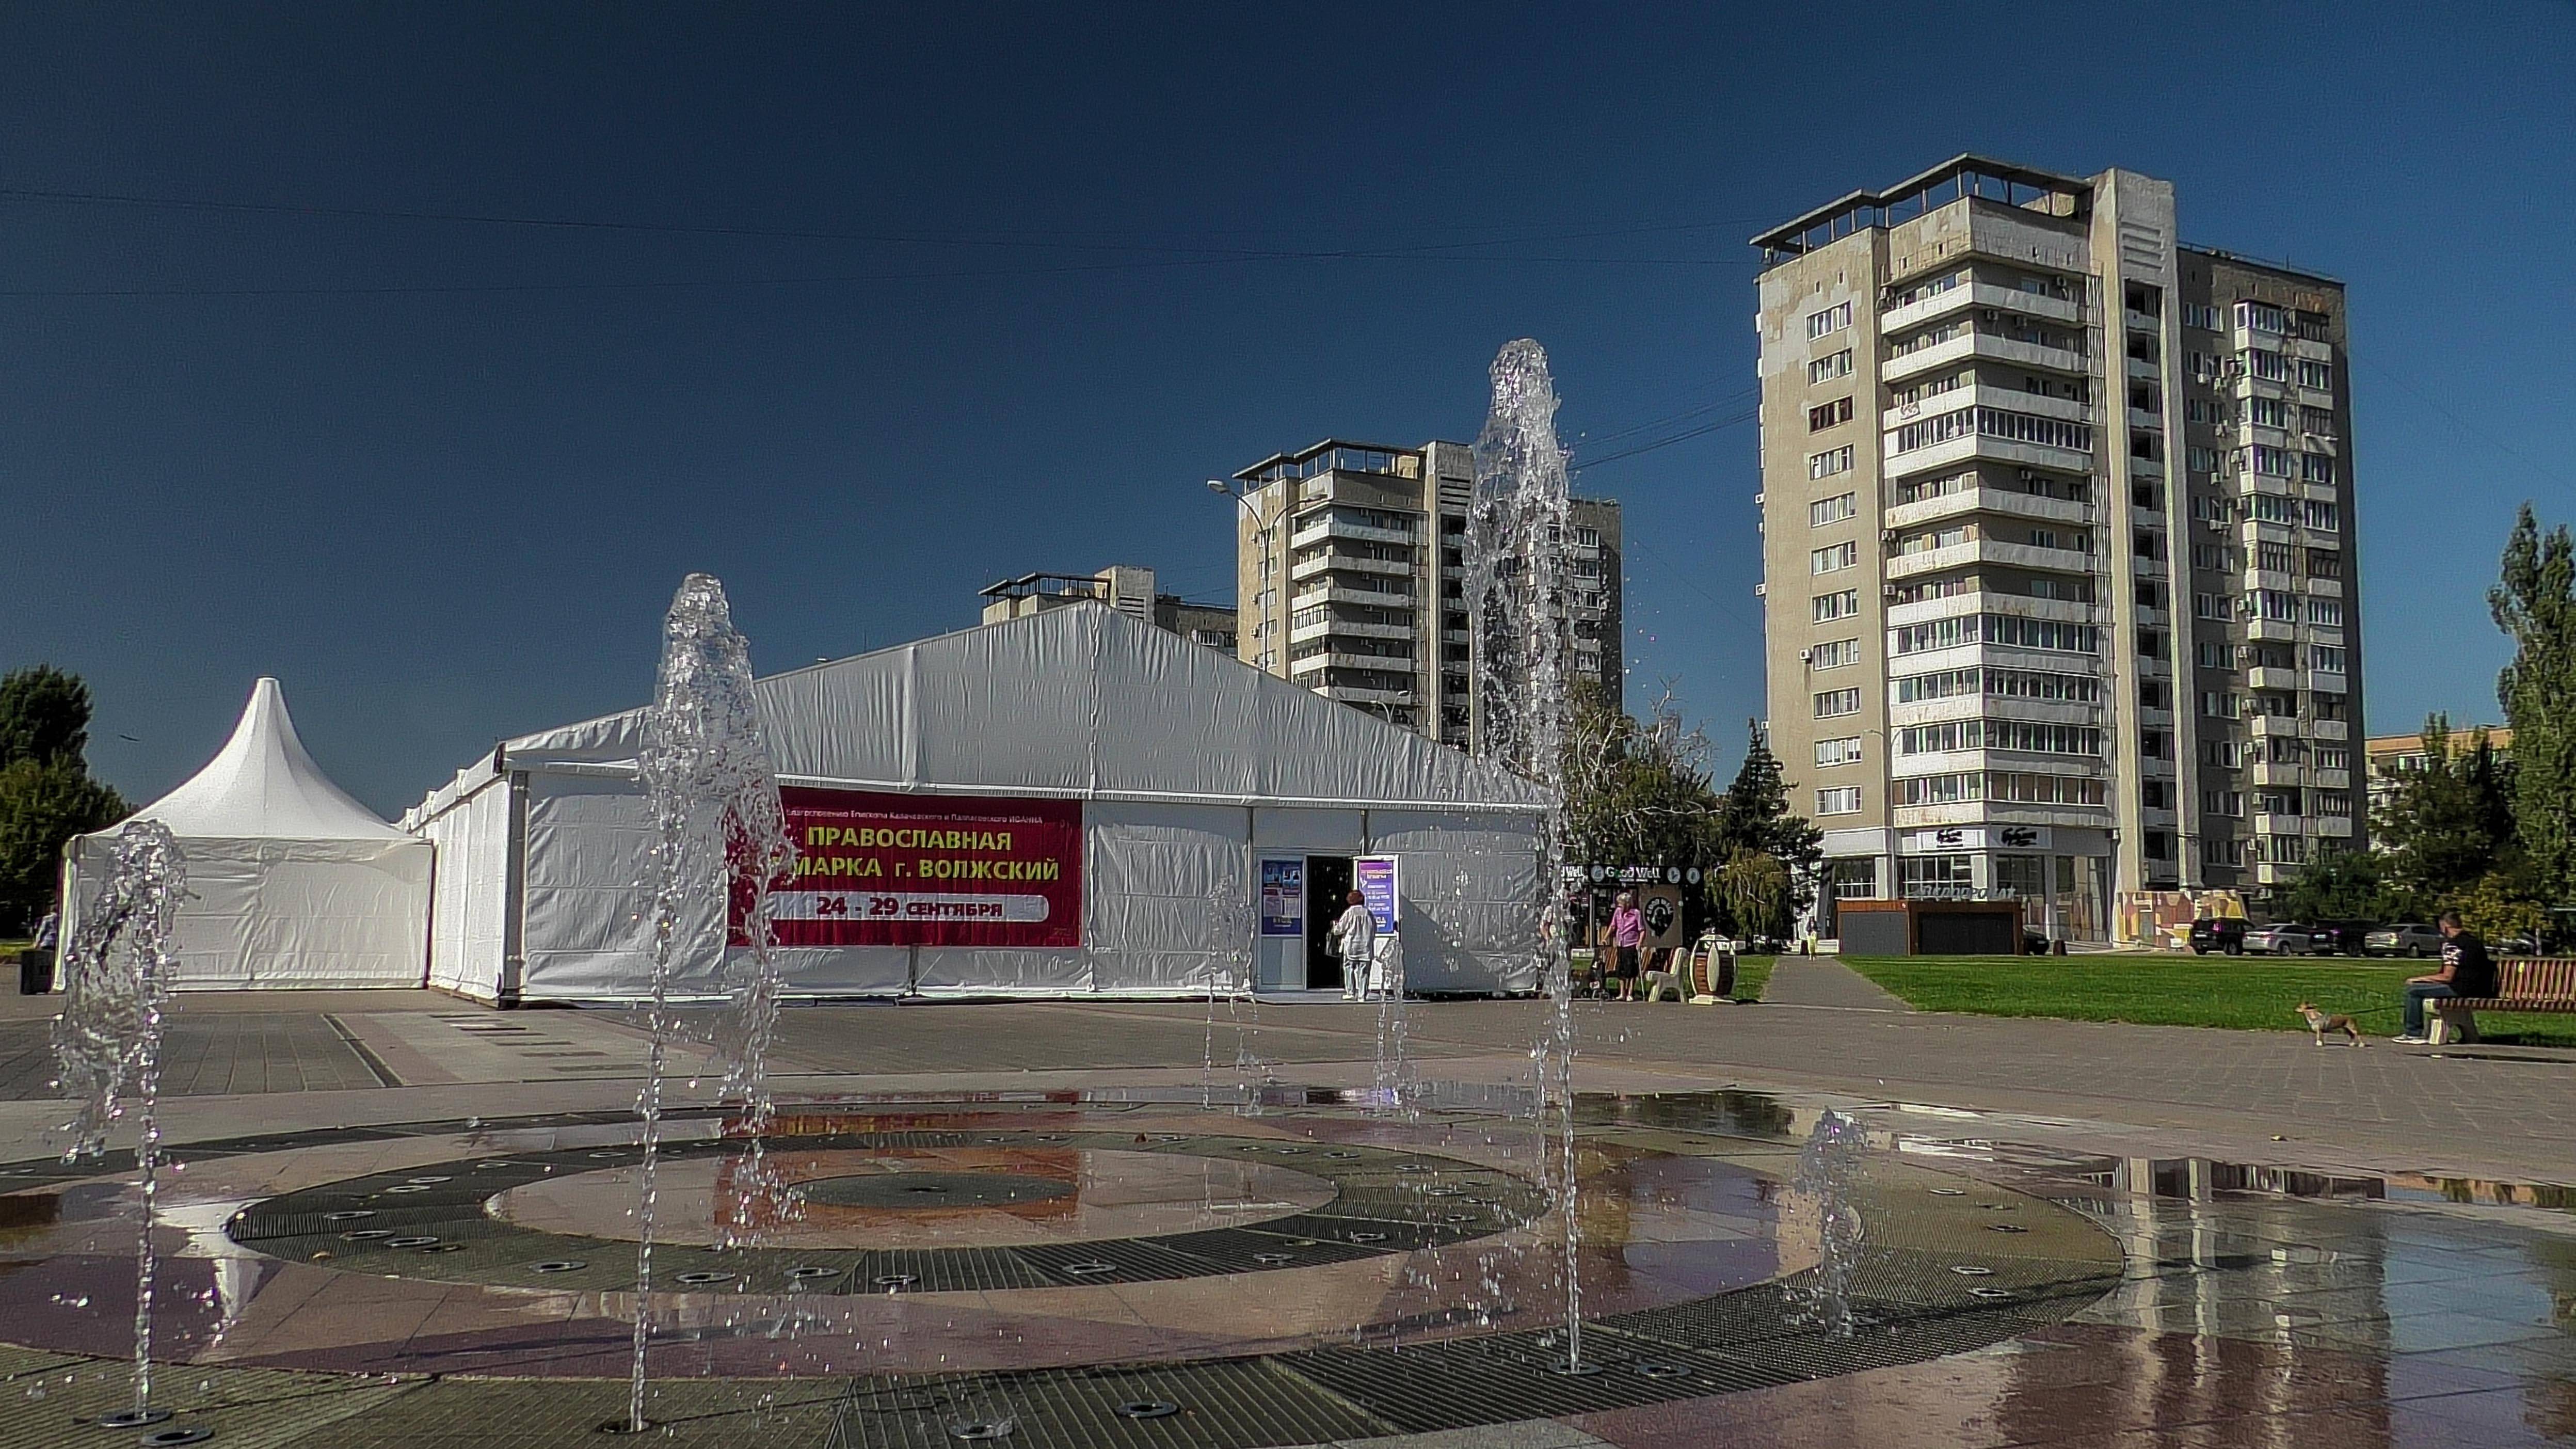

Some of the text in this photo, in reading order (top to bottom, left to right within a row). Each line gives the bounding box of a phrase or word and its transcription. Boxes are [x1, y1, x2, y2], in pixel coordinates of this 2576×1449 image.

[807, 826, 1012, 850] ПРАВОСЛАВНАЯ
[895, 862, 911, 878] г.
[919, 857, 1059, 881] ВОЛЖСКИЙ
[816, 897, 847, 915] 24
[869, 897, 899, 916] 29
[906, 903, 1003, 917] СЕНТЯБРЯ
